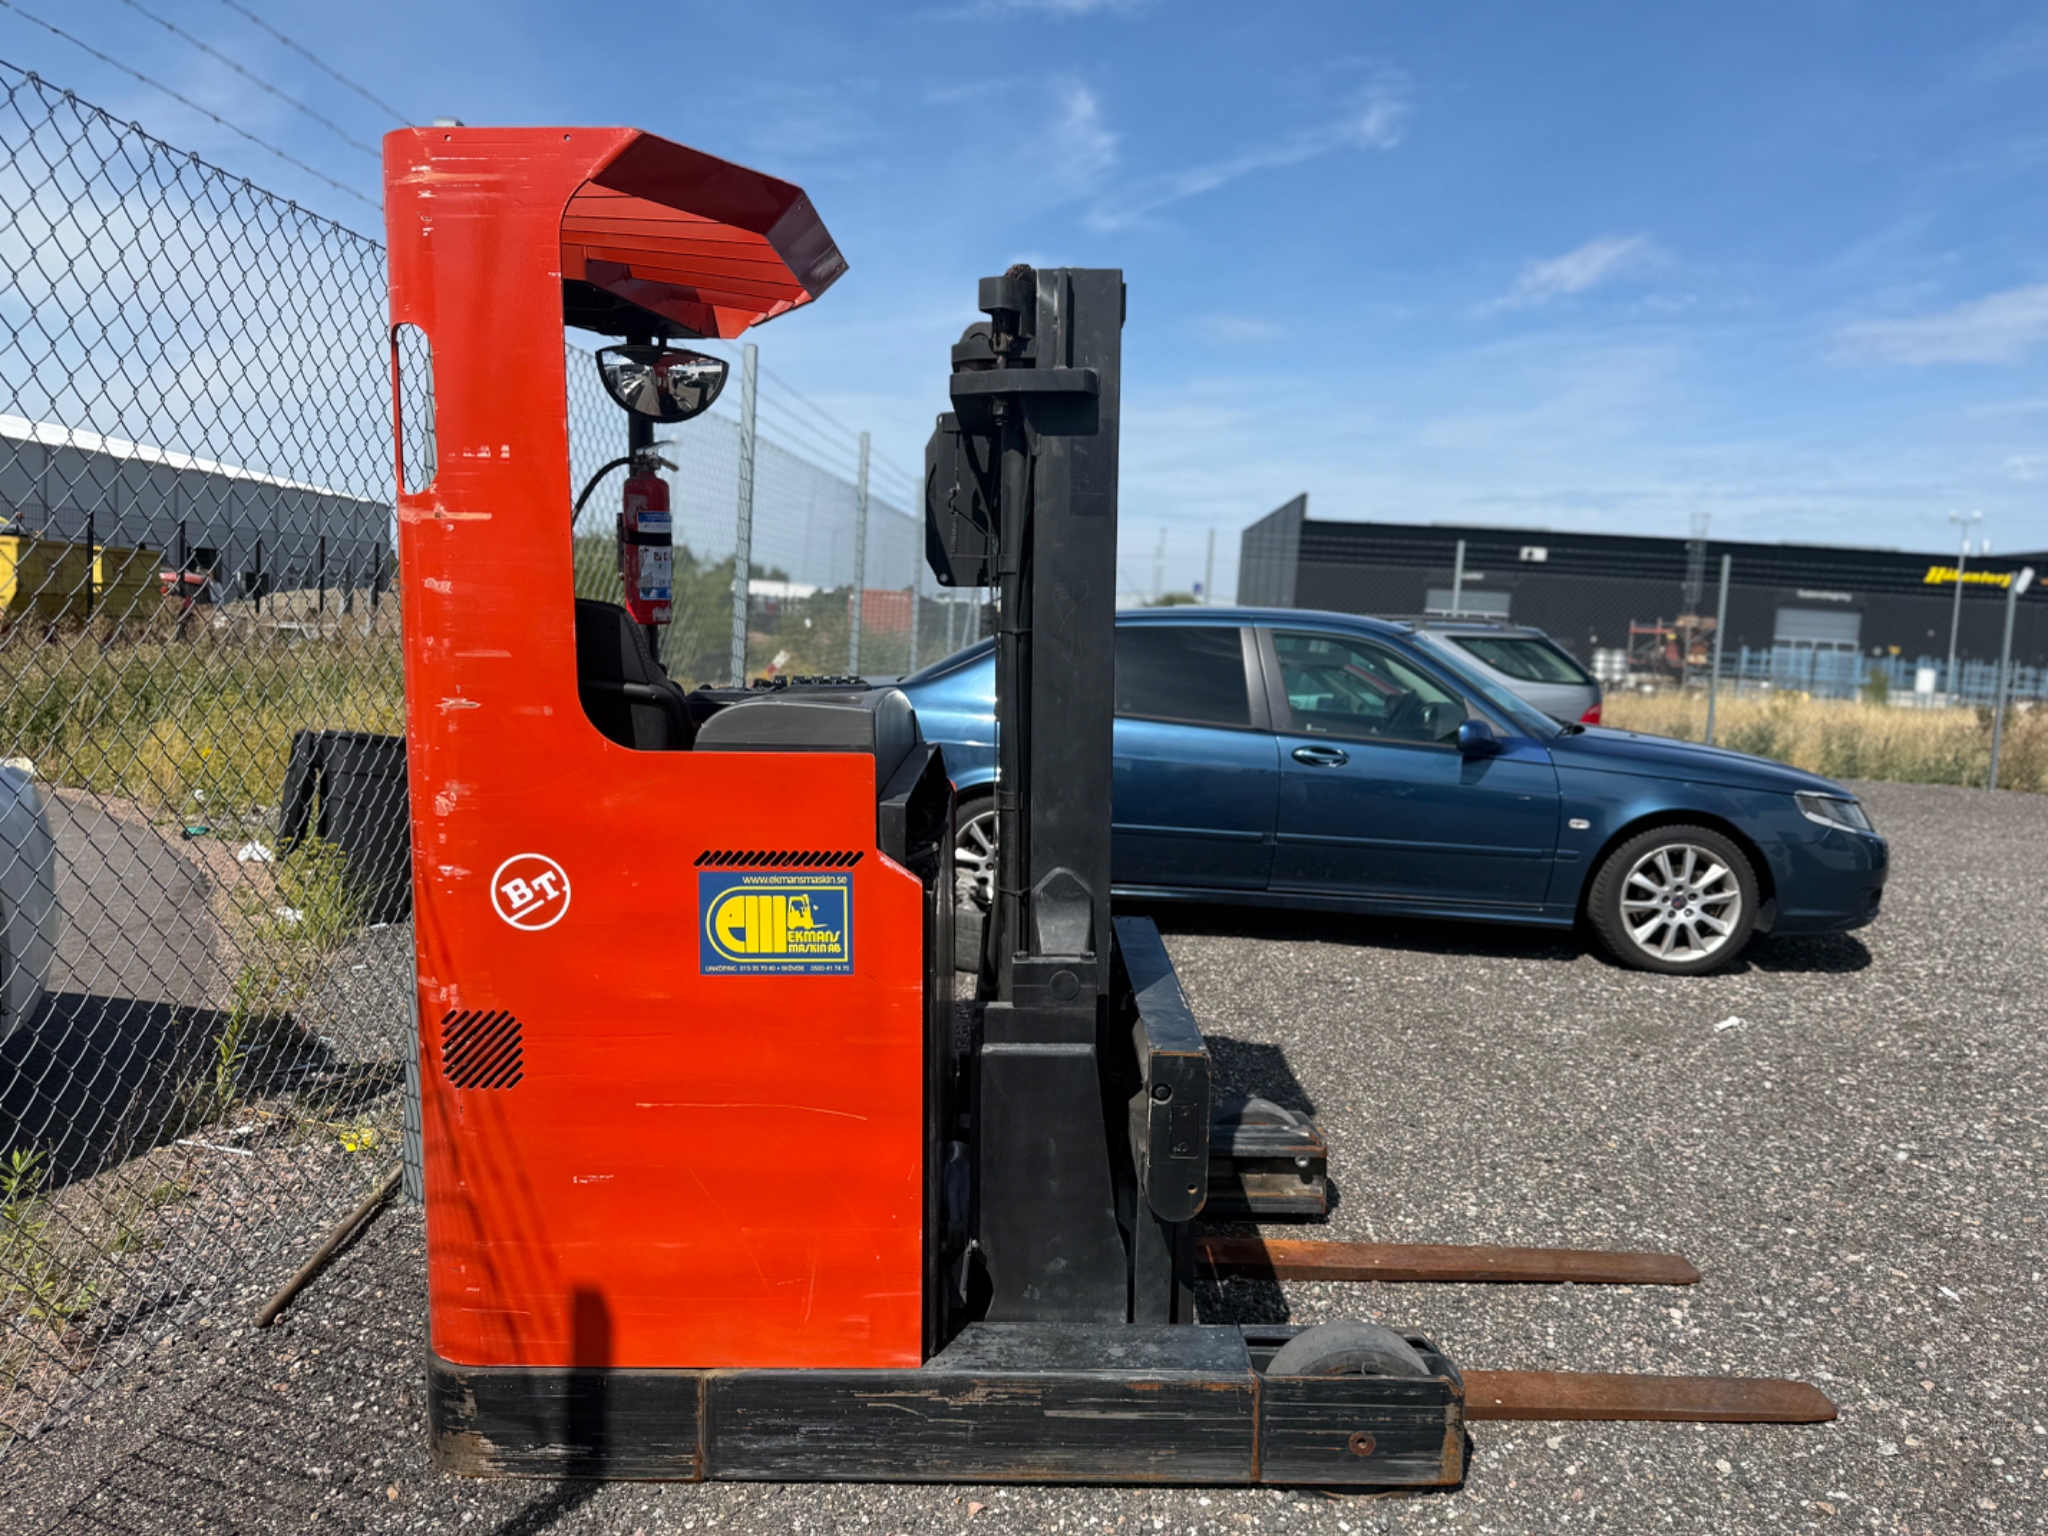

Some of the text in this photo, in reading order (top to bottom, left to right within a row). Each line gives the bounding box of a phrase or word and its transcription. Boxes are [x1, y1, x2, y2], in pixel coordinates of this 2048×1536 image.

[742, 875, 847, 885] www.ekmansmaskin.se
[500, 870, 560, 910] BT
[788, 930, 841, 943] EKMANS
[828, 943, 842, 953] AB
